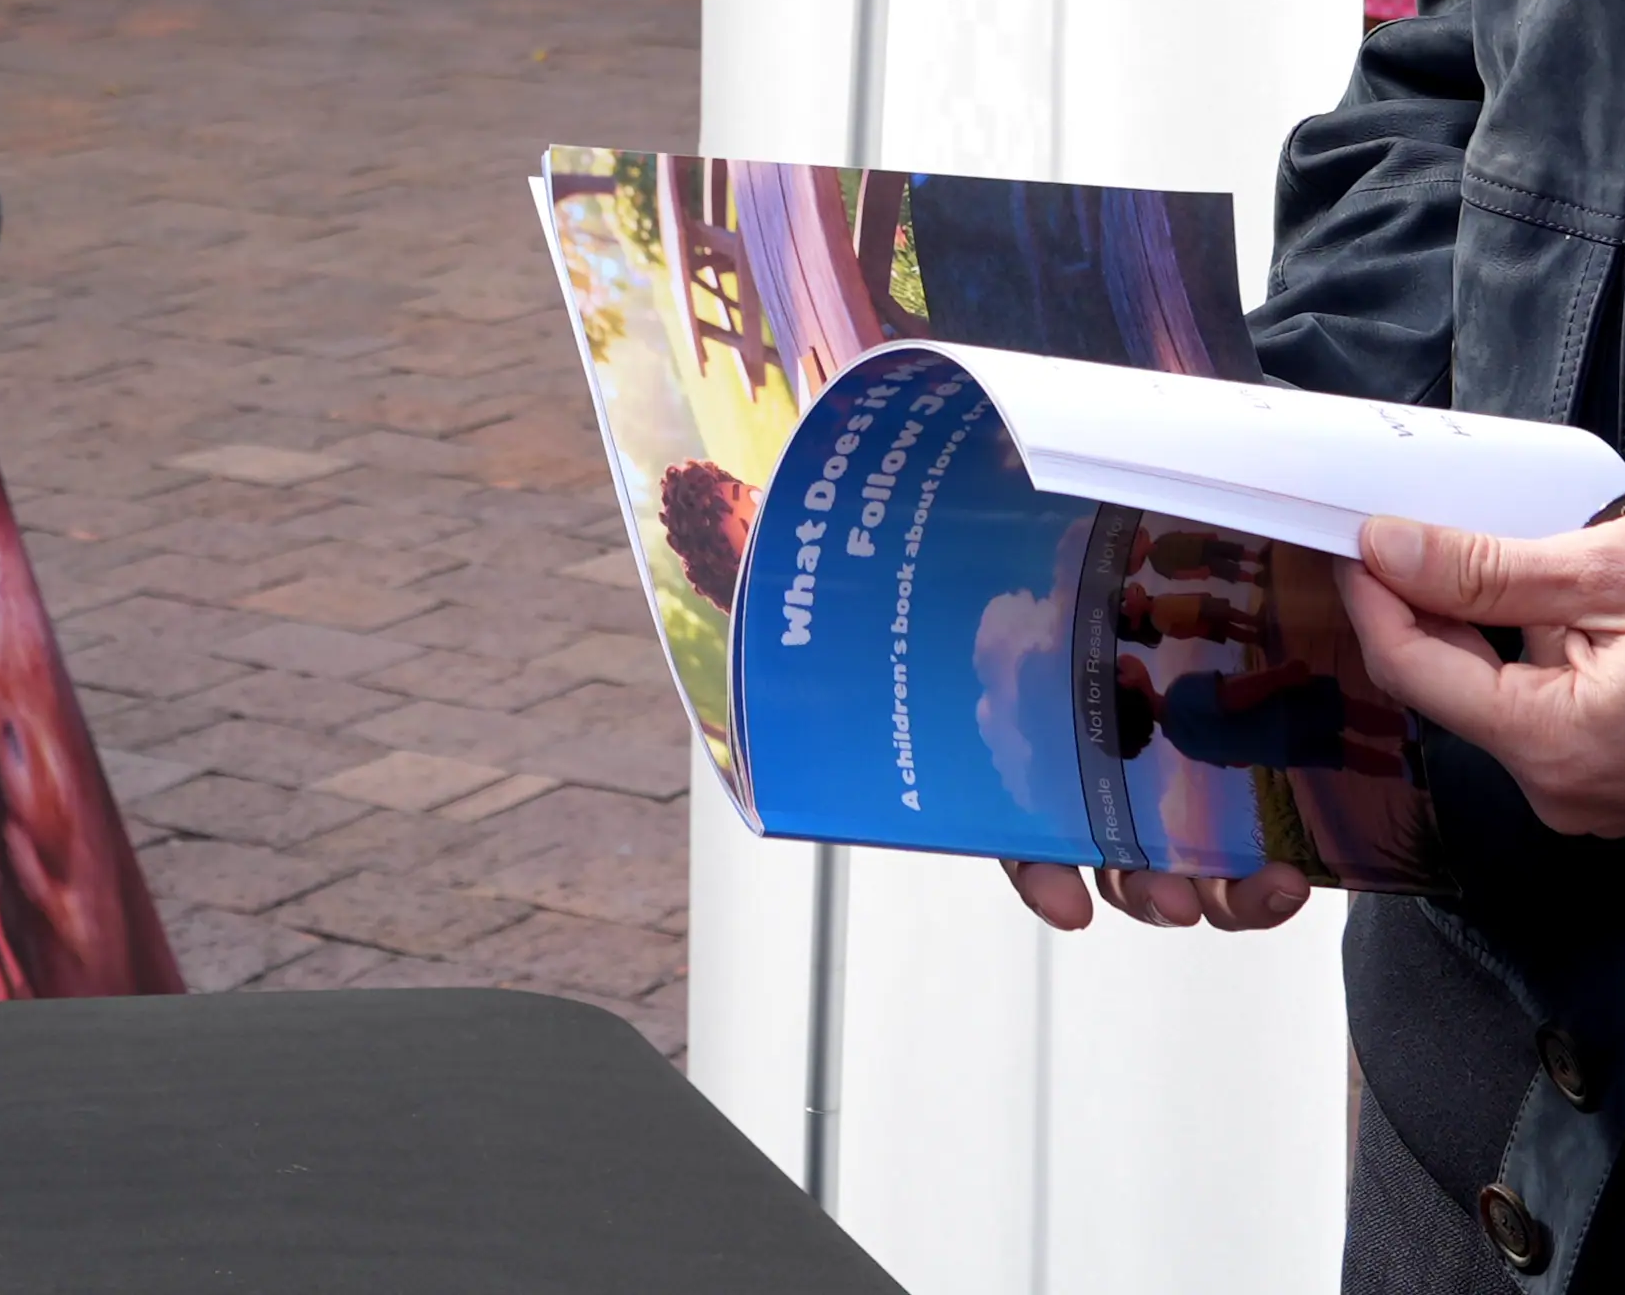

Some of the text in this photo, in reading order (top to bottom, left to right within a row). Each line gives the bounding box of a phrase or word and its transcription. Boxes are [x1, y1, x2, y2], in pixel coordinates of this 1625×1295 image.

[846, 419, 924, 557] Follow
[927, 425, 971, 477] love,
[780, 519, 827, 646] What
[804, 413, 874, 512] Does
[854, 384, 901, 409] it
[904, 480, 940, 558] about
[890, 562, 915, 634] book
[890, 638, 916, 786] children's
[1086, 608, 1104, 743] Not for Resale
[901, 789, 921, 811] A
[1098, 777, 1121, 842] Resale
